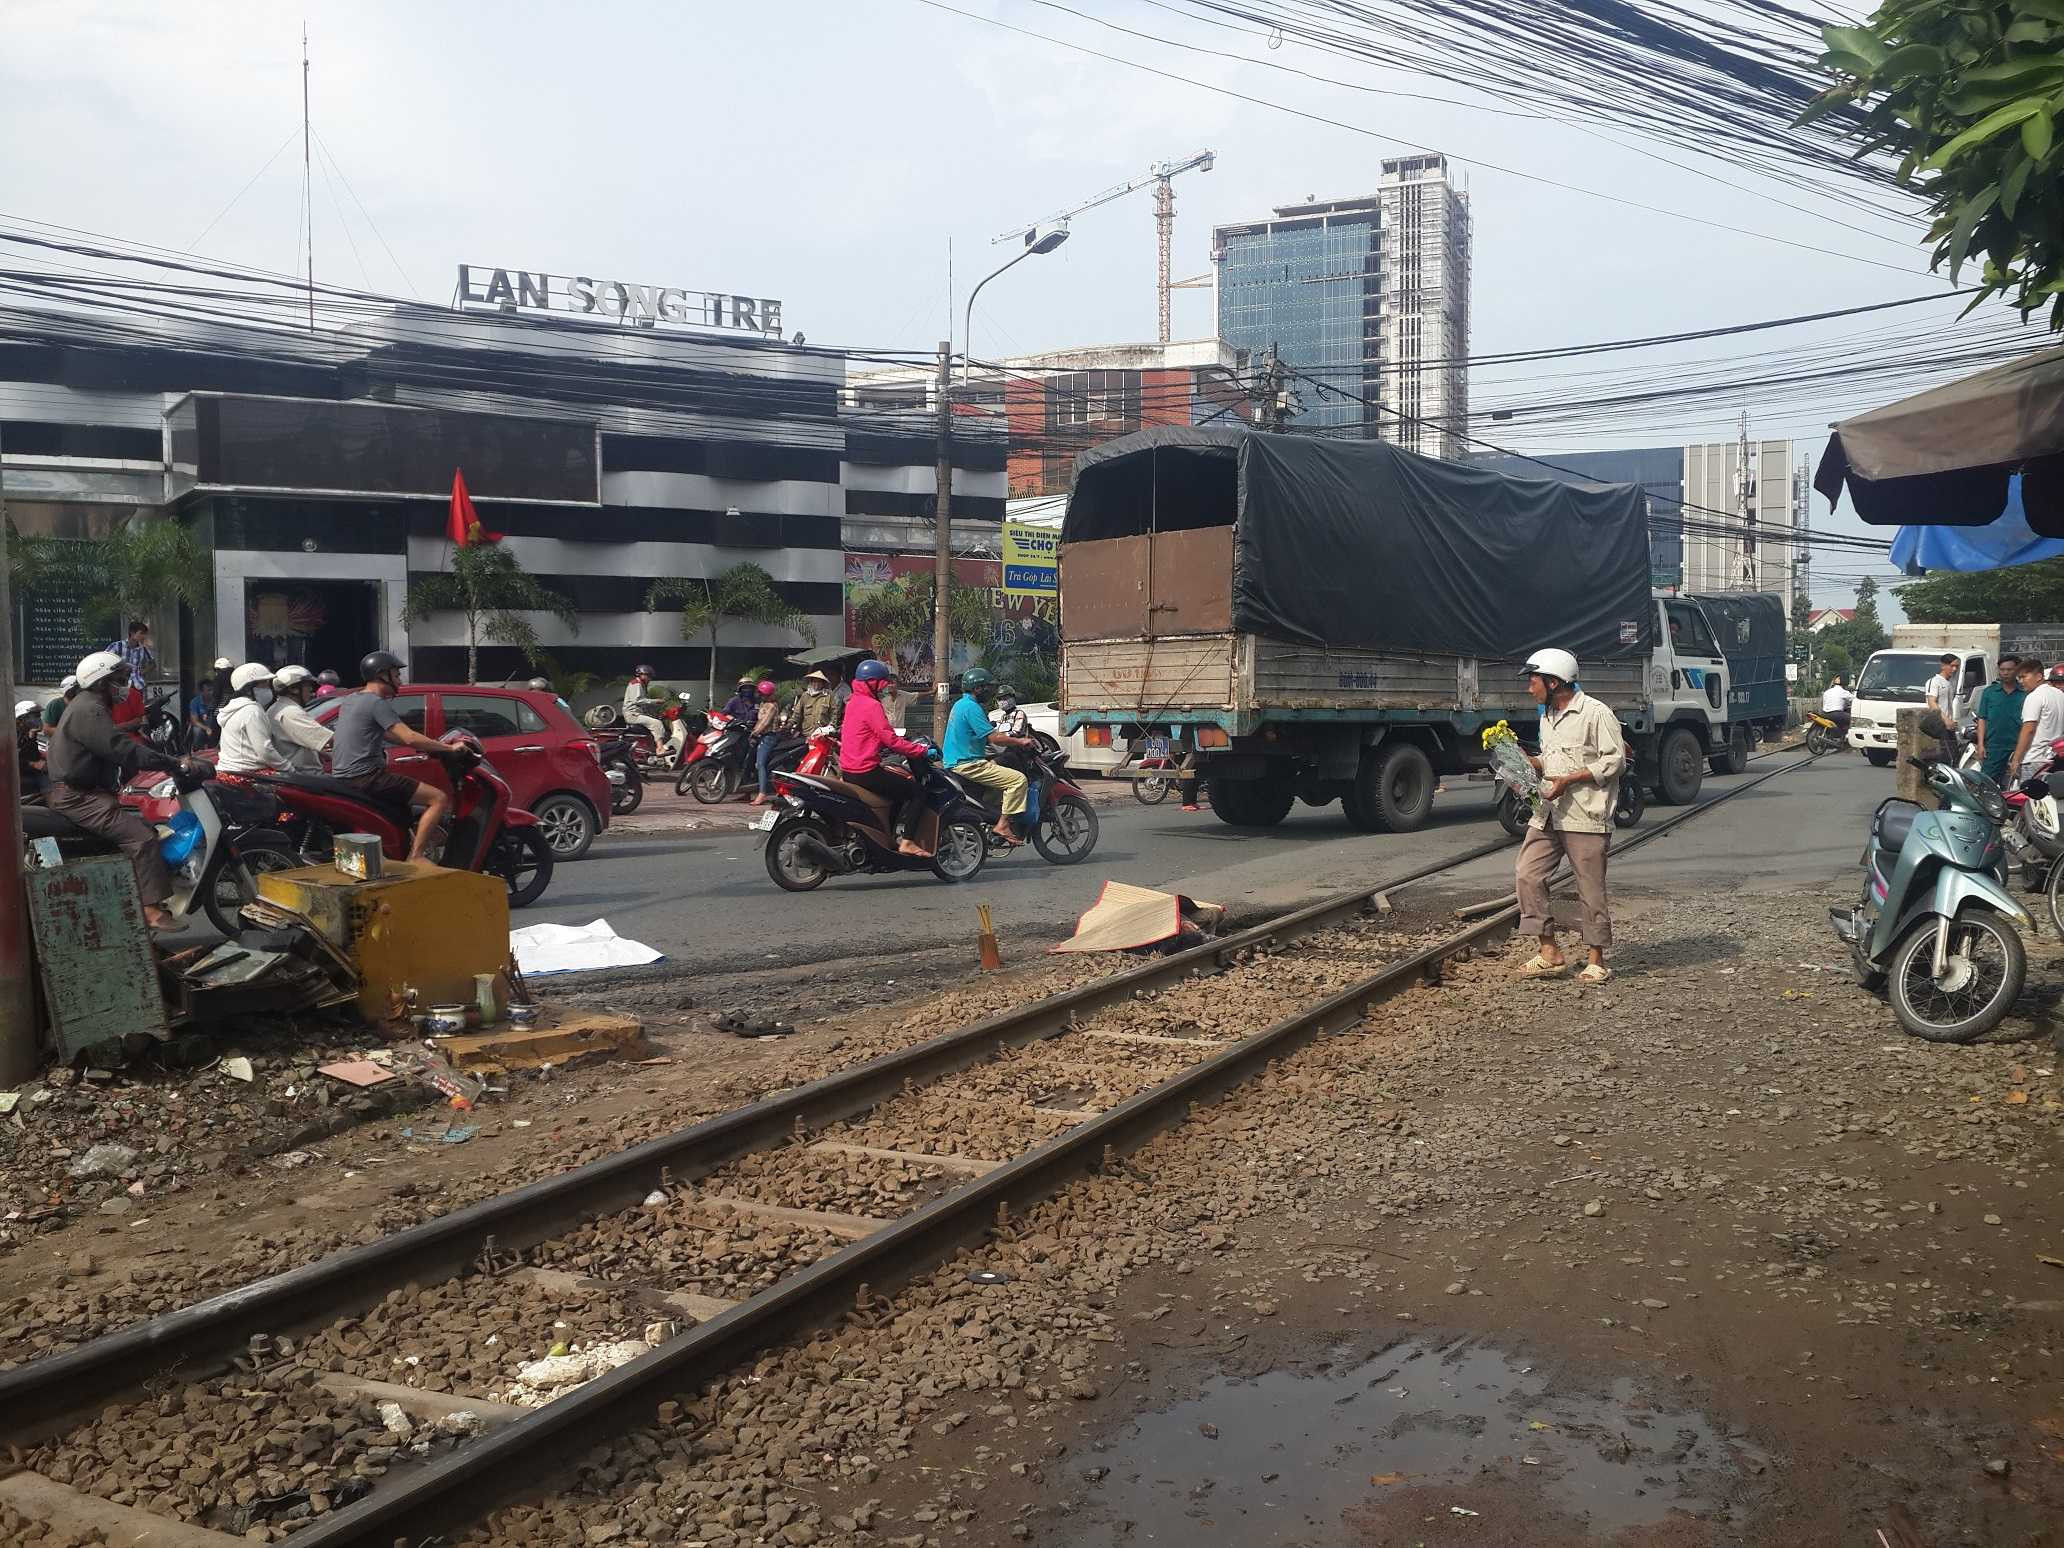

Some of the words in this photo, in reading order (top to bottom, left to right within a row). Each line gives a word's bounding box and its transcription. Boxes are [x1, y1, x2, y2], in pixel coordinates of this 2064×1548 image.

[458, 264, 548, 309] LAN
[567, 276, 687, 324] SONG
[703, 292, 783, 334] TRE
[1032, 596, 1057, 626] YE
